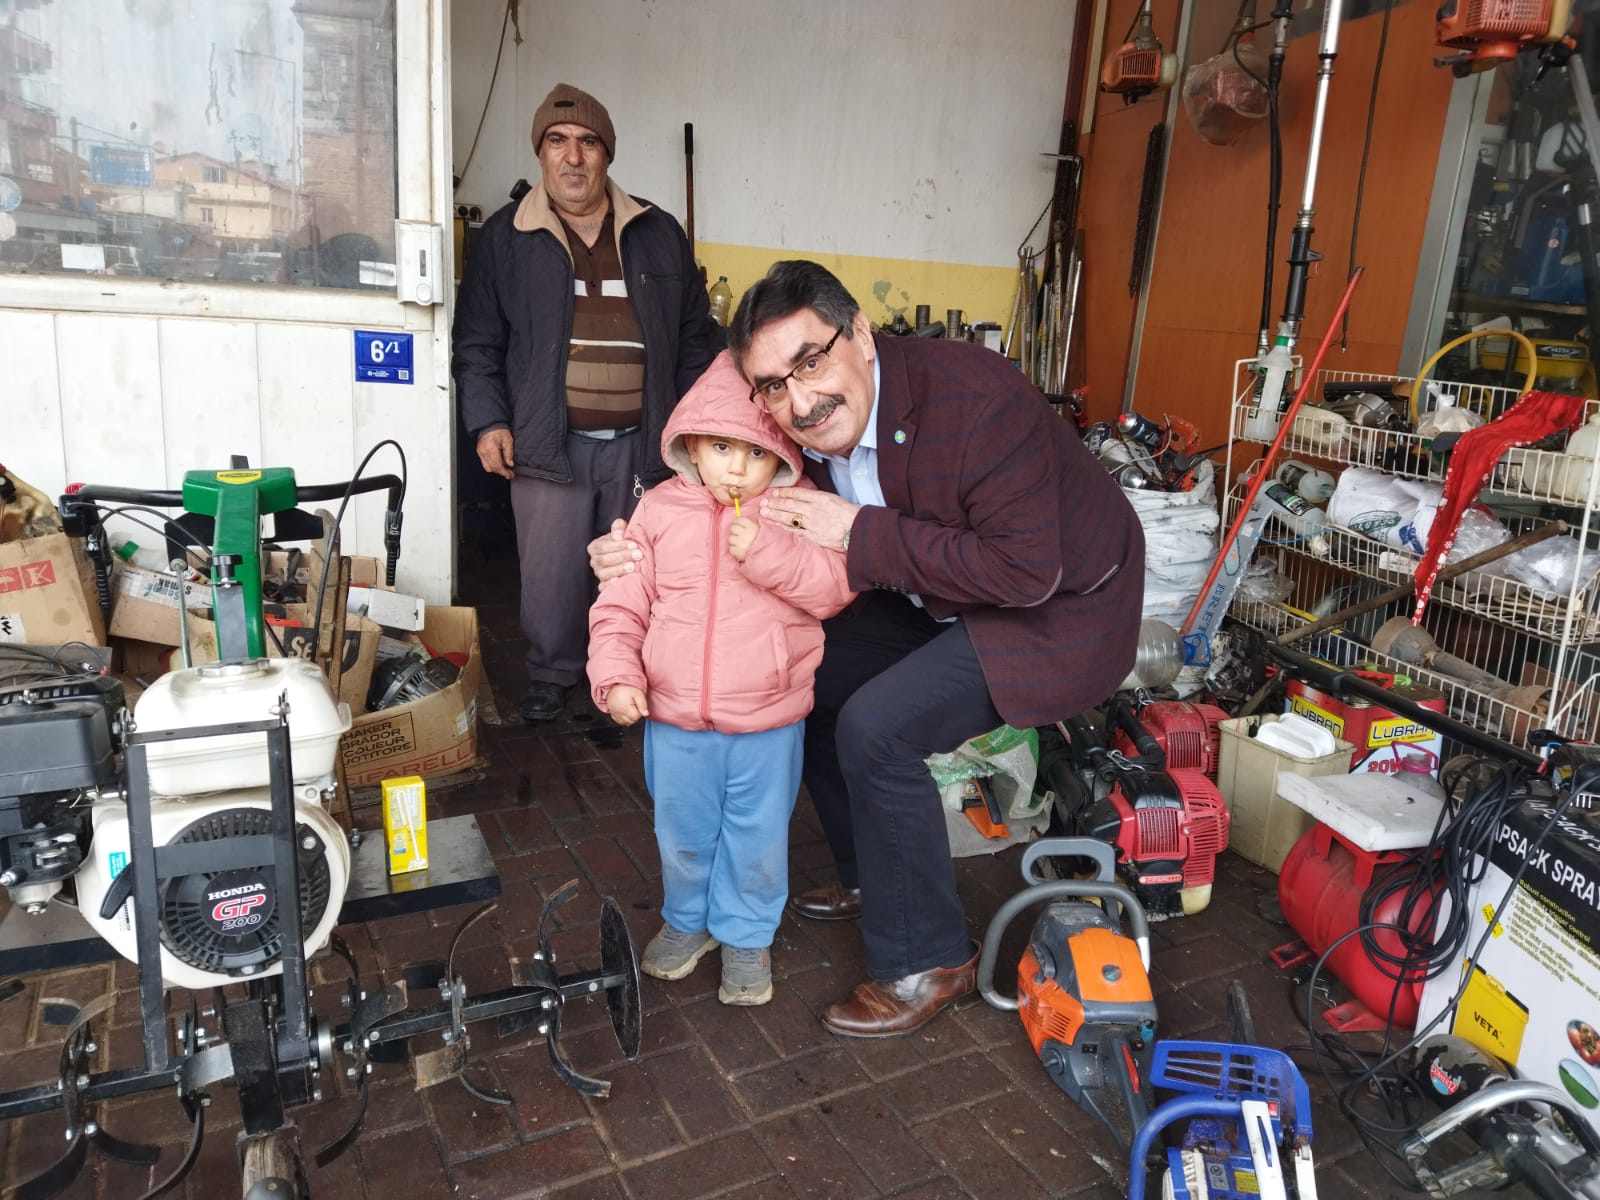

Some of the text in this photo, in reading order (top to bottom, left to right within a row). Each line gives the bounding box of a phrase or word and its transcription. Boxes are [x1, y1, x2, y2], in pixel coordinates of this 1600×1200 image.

[1293, 699, 1342, 739] LUBRAN
[343, 721, 392, 742] HAKER
[343, 728, 401, 750] BRADOR
[1373, 723, 1434, 740] LUBRA
[343, 735, 406, 758] COUEUR
[207, 882, 267, 901] HONDA
[212, 893, 267, 921] GP
[222, 913, 262, 931] 200
[1473, 1010, 1499, 1040] VETA
